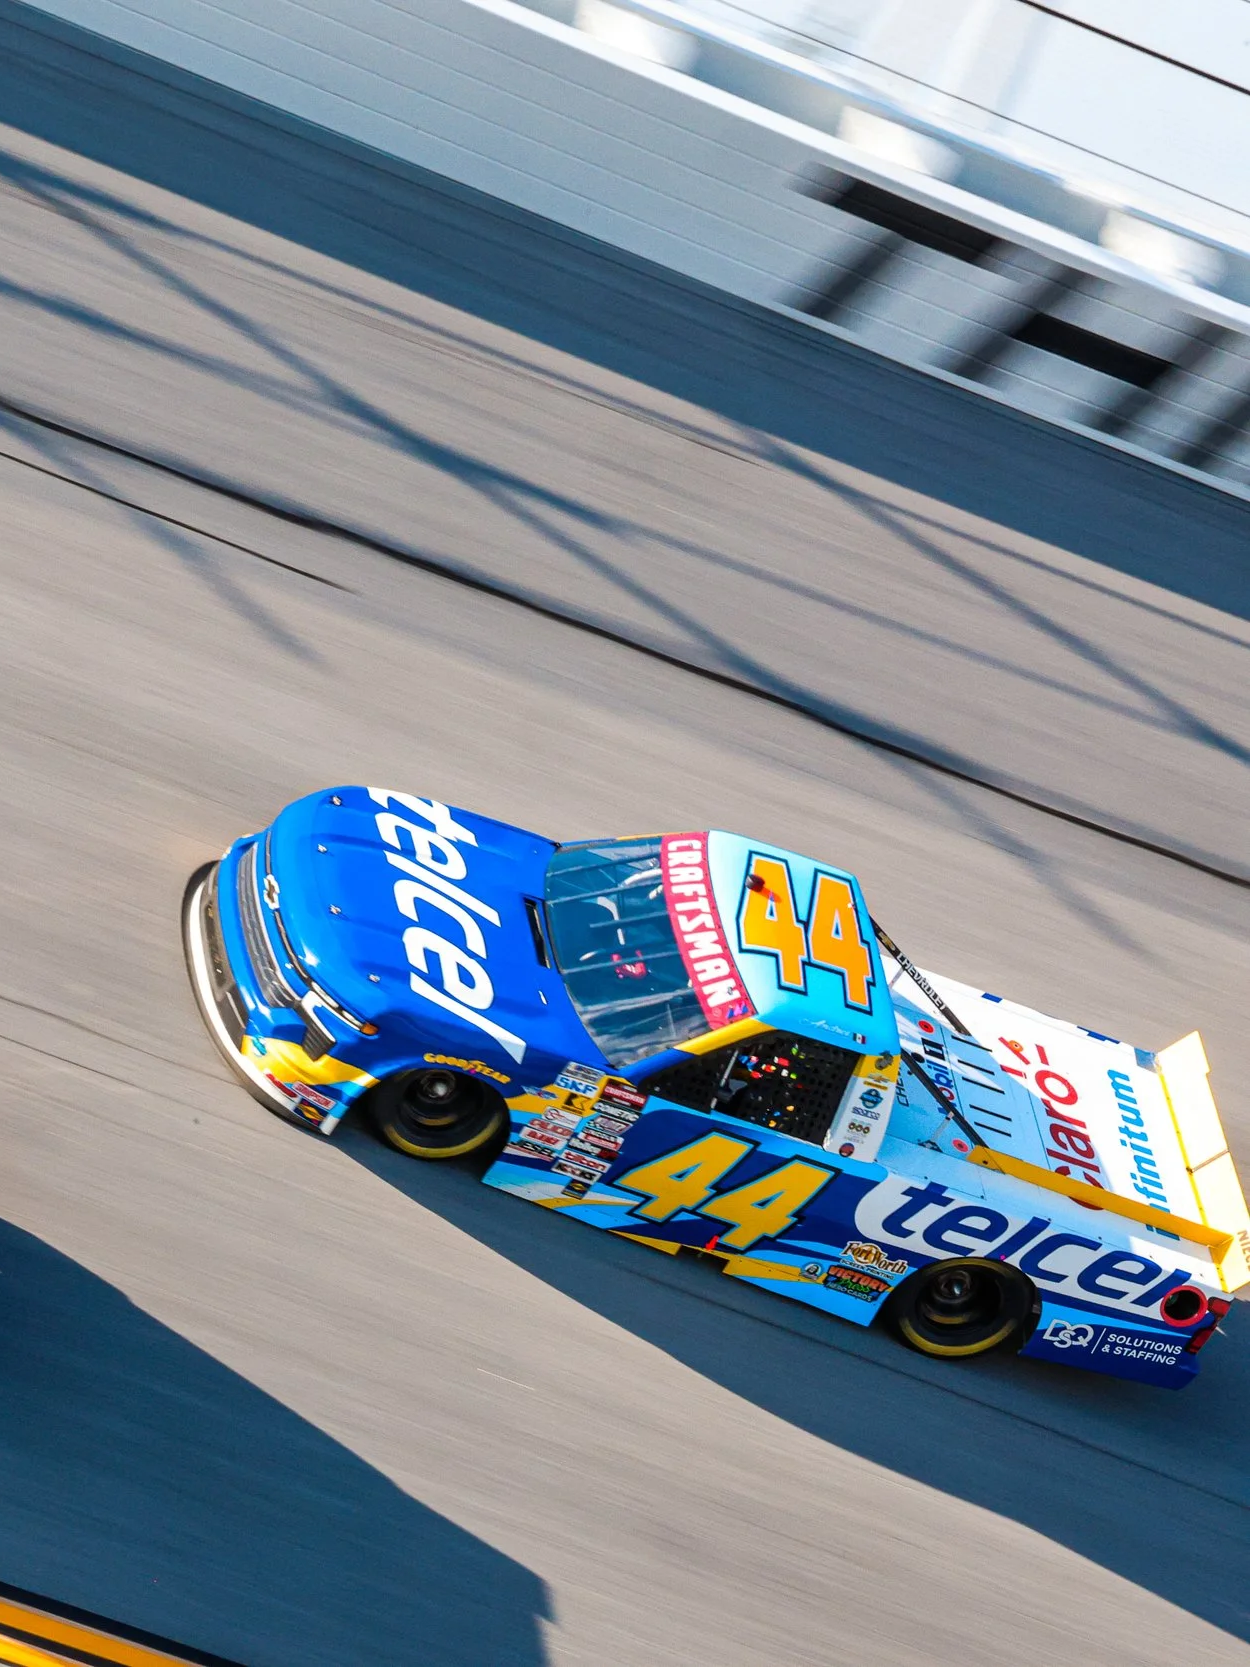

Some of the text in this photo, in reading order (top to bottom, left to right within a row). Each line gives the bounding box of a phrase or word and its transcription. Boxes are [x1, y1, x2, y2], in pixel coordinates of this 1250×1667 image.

[367, 786, 527, 1065] telcel
[668, 839, 742, 1008] CRAFTSMAN
[737, 849, 876, 1016] 44
[896, 952, 948, 1012] CHEVROLET
[423, 1052, 511, 1084] GOODYEAR
[554, 1077, 598, 1095] SKF
[593, 1101, 640, 1122] COMETIC
[608, 1126, 843, 1254] 44
[881, 1180, 1193, 1309] telcel
[867, 1266, 895, 1280] PRINTING
[870, 1250, 909, 1276] Worth
[828, 1265, 890, 1292] VICTORY
[847, 1289, 873, 1302] CARDS
[1101, 1344, 1177, 1366] & STAFFING
[1107, 1333, 1183, 1355] SOLUTIONS
